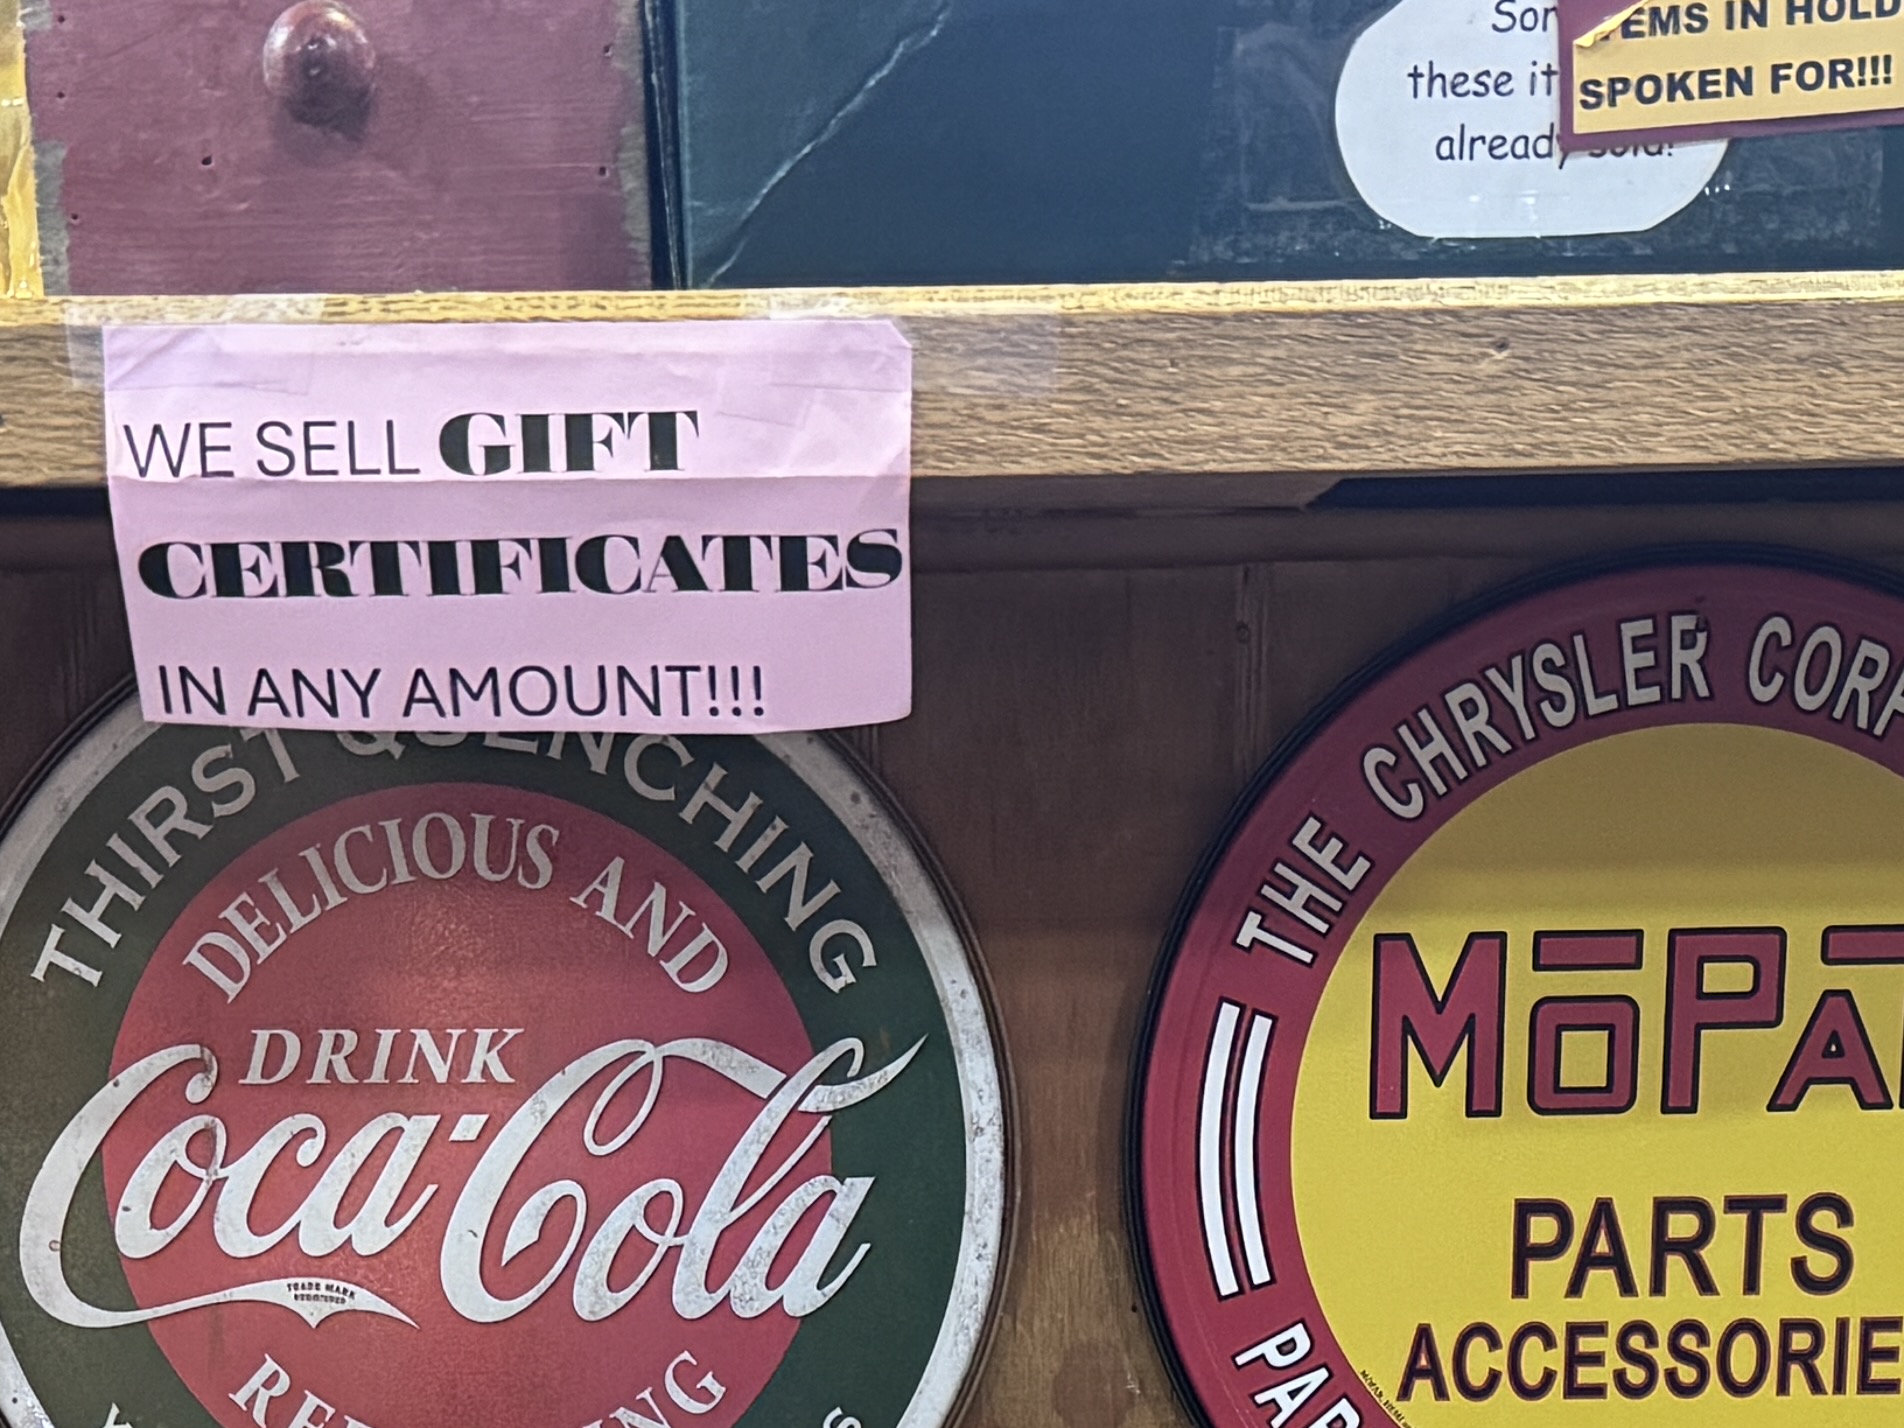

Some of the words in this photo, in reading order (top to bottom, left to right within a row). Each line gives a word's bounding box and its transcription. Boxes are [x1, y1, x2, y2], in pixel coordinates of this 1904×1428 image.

[1407, 61, 1513, 98] these
[1579, 66, 1753, 110] SPOKEN
[1771, 55, 1894, 94] FOR!!!
[124, 421, 233, 477] WE
[256, 418, 420, 477] SELL
[438, 410, 699, 476] GIFT
[138, 529, 903, 598] CERTIFICATES
[158, 666, 225, 714] IN
[246, 666, 381, 718] ANY
[402, 664, 765, 717] AMOUNT!!!
[1236, 817, 1374, 964] THE
[1363, 614, 1712, 821] CHRYSLER
[30, 725, 299, 992] THIRST
[181, 809, 559, 1003] DELICIOUS
[572, 856, 731, 994] AND
[238, 1027, 524, 1085] DRINK
[18, 1032, 928, 1330] Coca-Cola
[1509, 1193, 1857, 1300] PARTS
